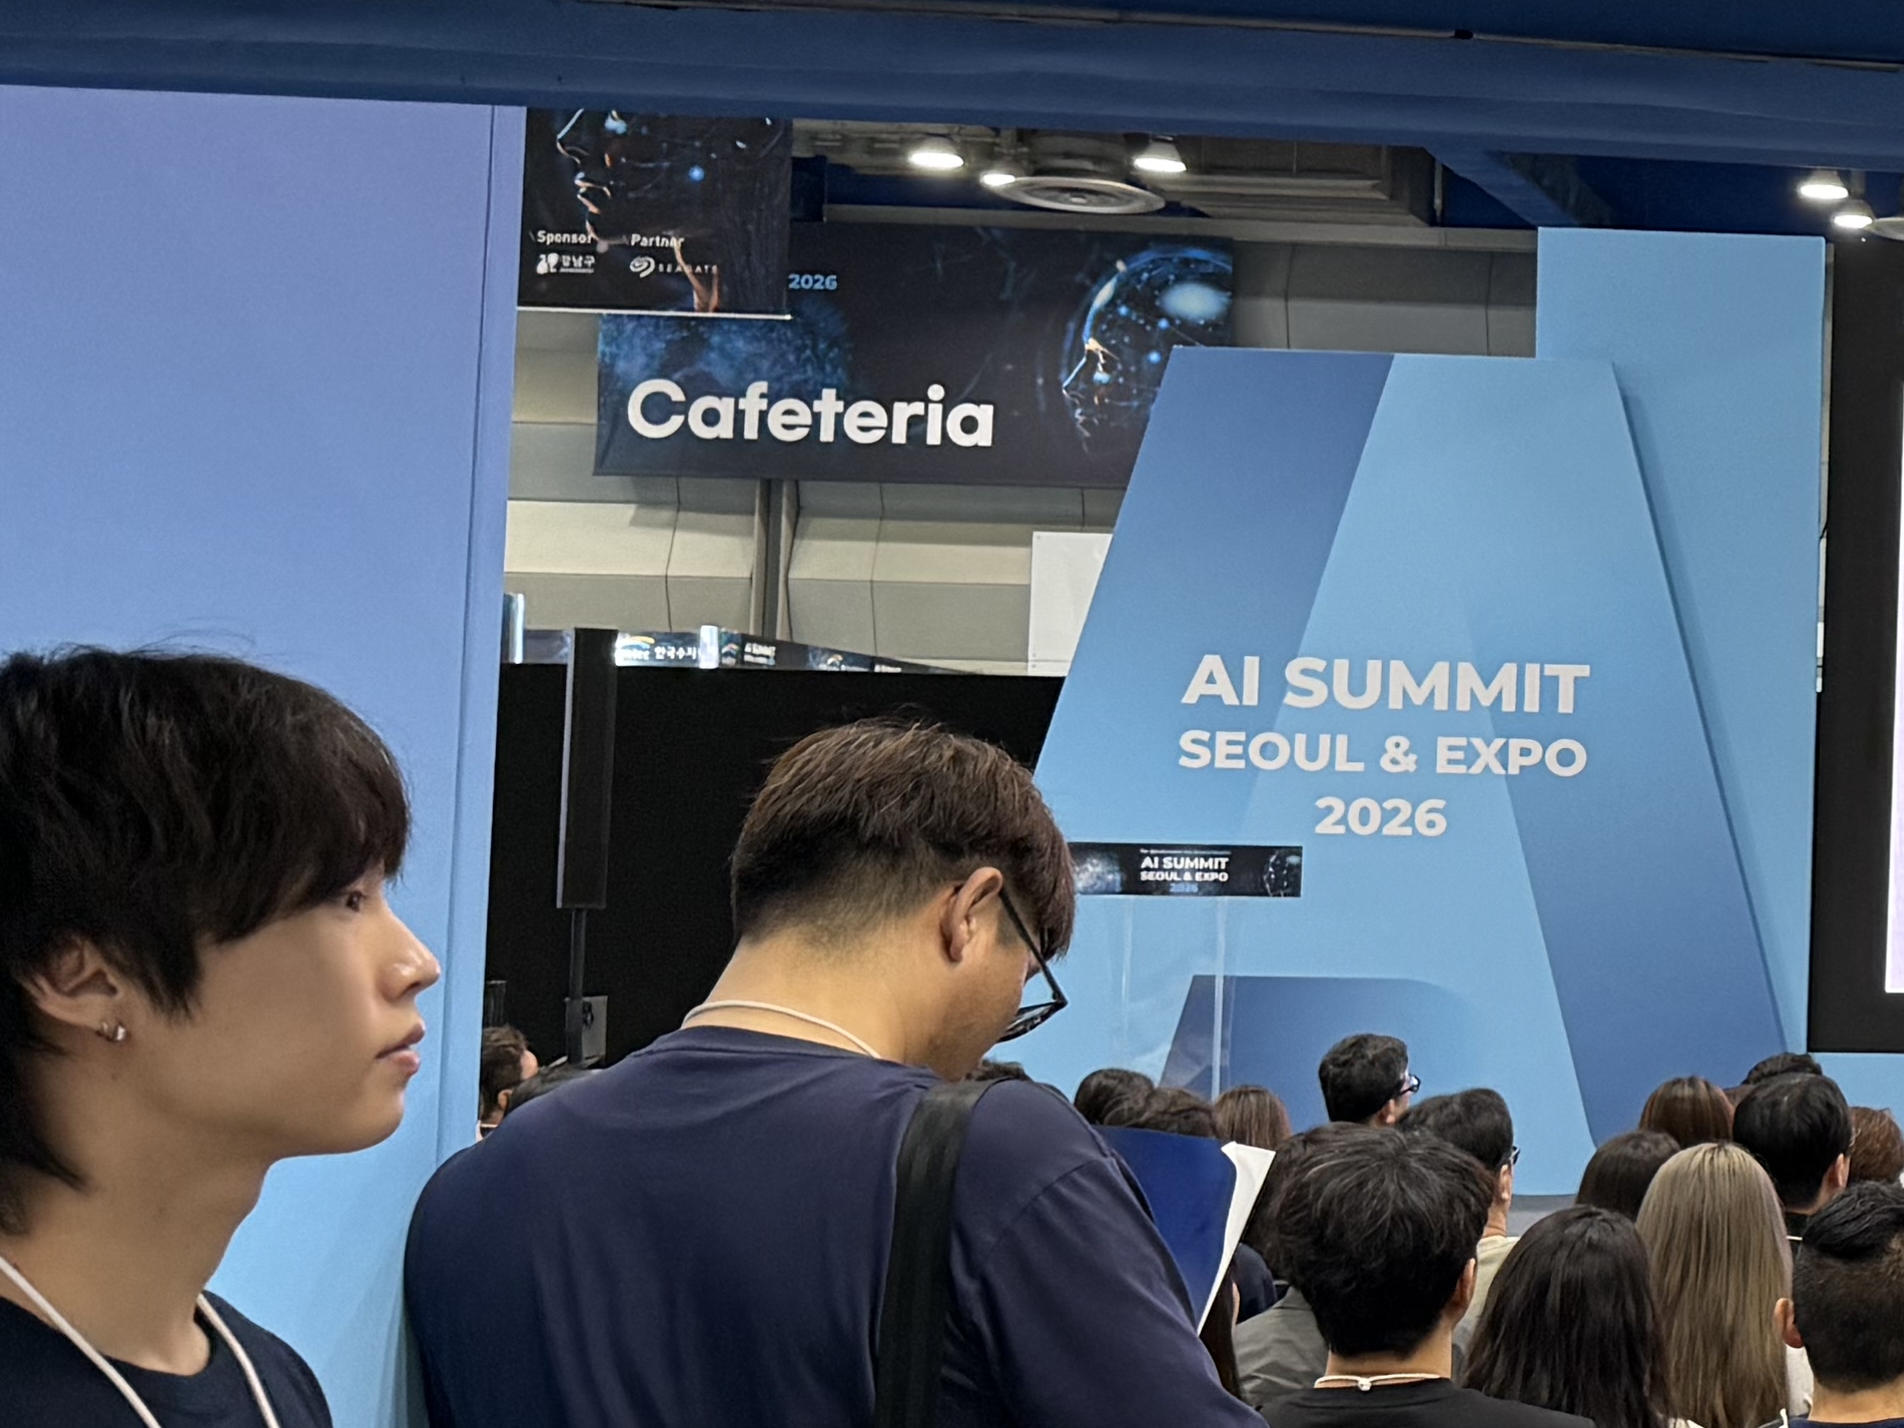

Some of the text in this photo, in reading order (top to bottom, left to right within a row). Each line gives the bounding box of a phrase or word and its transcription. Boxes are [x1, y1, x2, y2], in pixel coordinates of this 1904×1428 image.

[537, 230, 593, 247] Sponsor
[631, 233, 685, 248] Partner
[788, 273, 838, 291] 2026
[626, 377, 995, 448] Cafeteria
[1181, 653, 1591, 715] AI SUMMIT
[1178, 729, 1588, 778] SEOUL & EXPO
[1313, 796, 1448, 837] 2026
[1140, 856, 1230, 870] AI SUMMIT
[1140, 870, 1182, 882] SEOUL
[1195, 871, 1229, 882] EXPO
